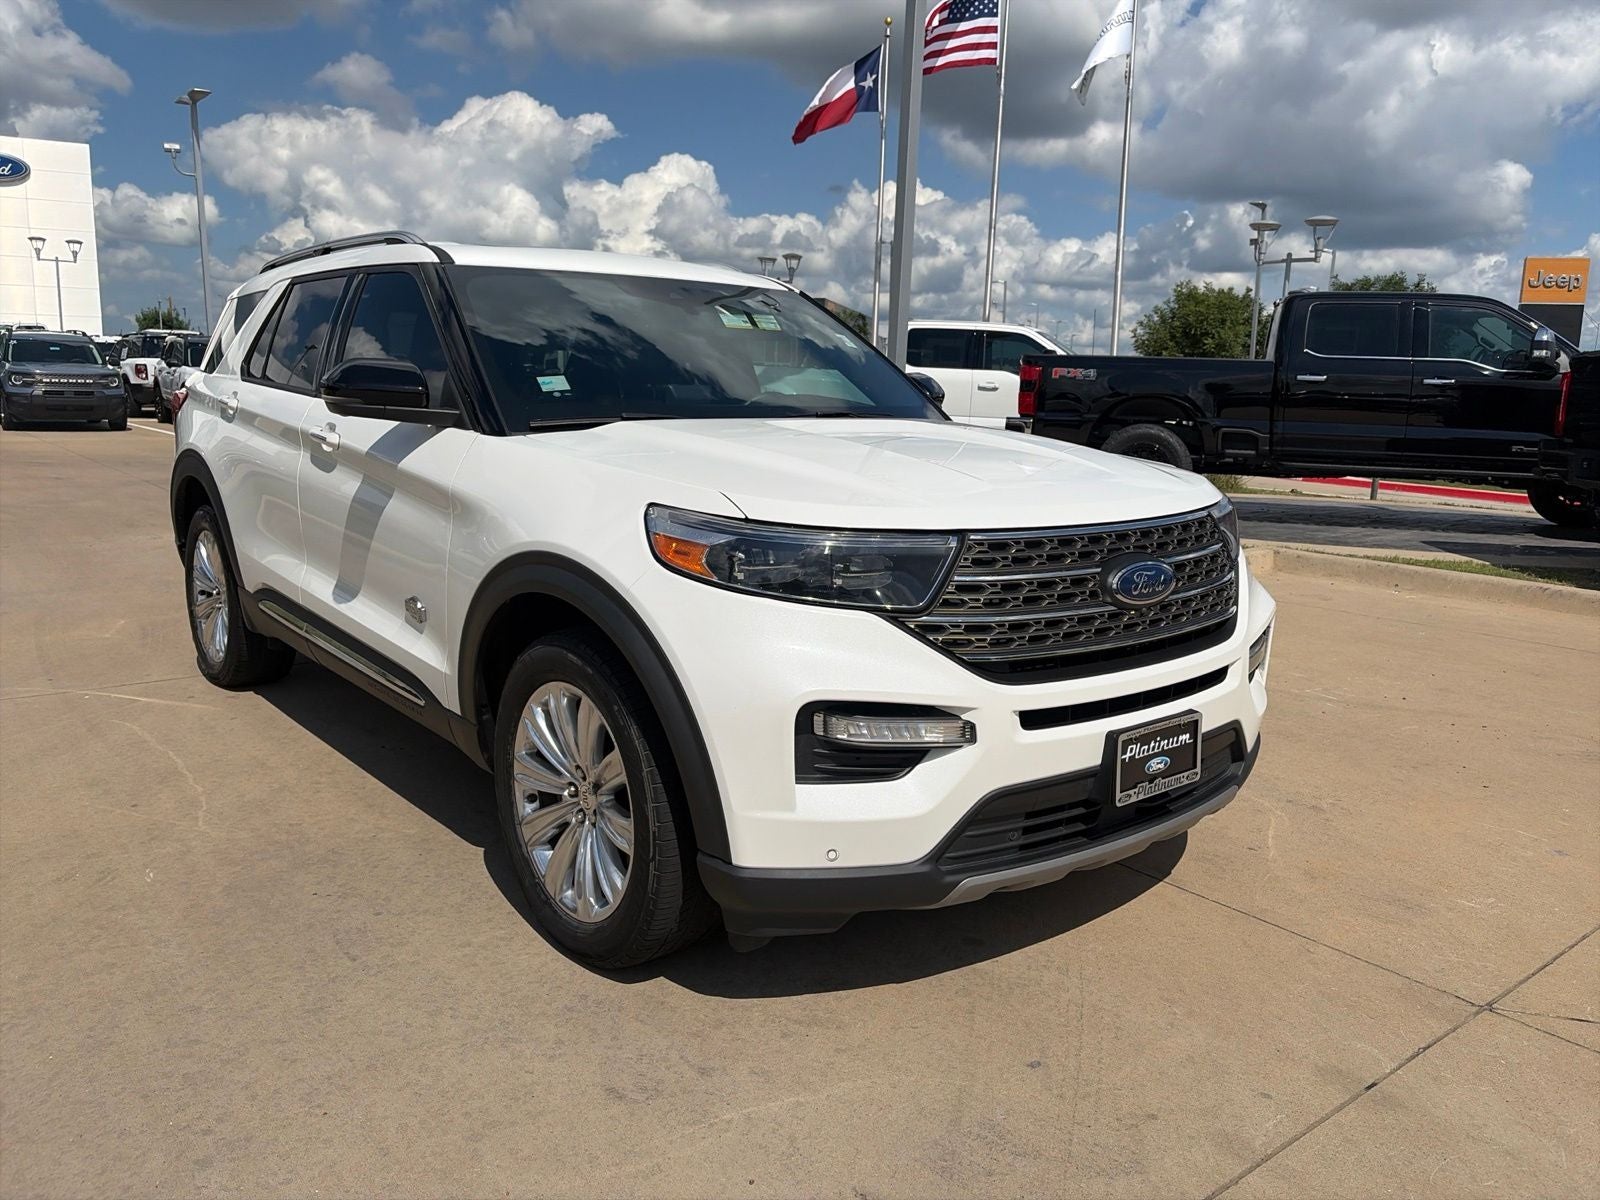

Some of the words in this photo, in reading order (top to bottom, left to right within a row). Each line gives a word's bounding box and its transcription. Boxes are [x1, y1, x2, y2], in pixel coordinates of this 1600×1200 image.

[1528, 269, 1583, 292] Jeep
[1052, 367, 1097, 380] FX4
[1131, 570, 1165, 595] Ford
[1121, 733, 1194, 762] Platinum
[1149, 760, 1166, 772] Ford
[1136, 776, 1185, 799] Platinum
